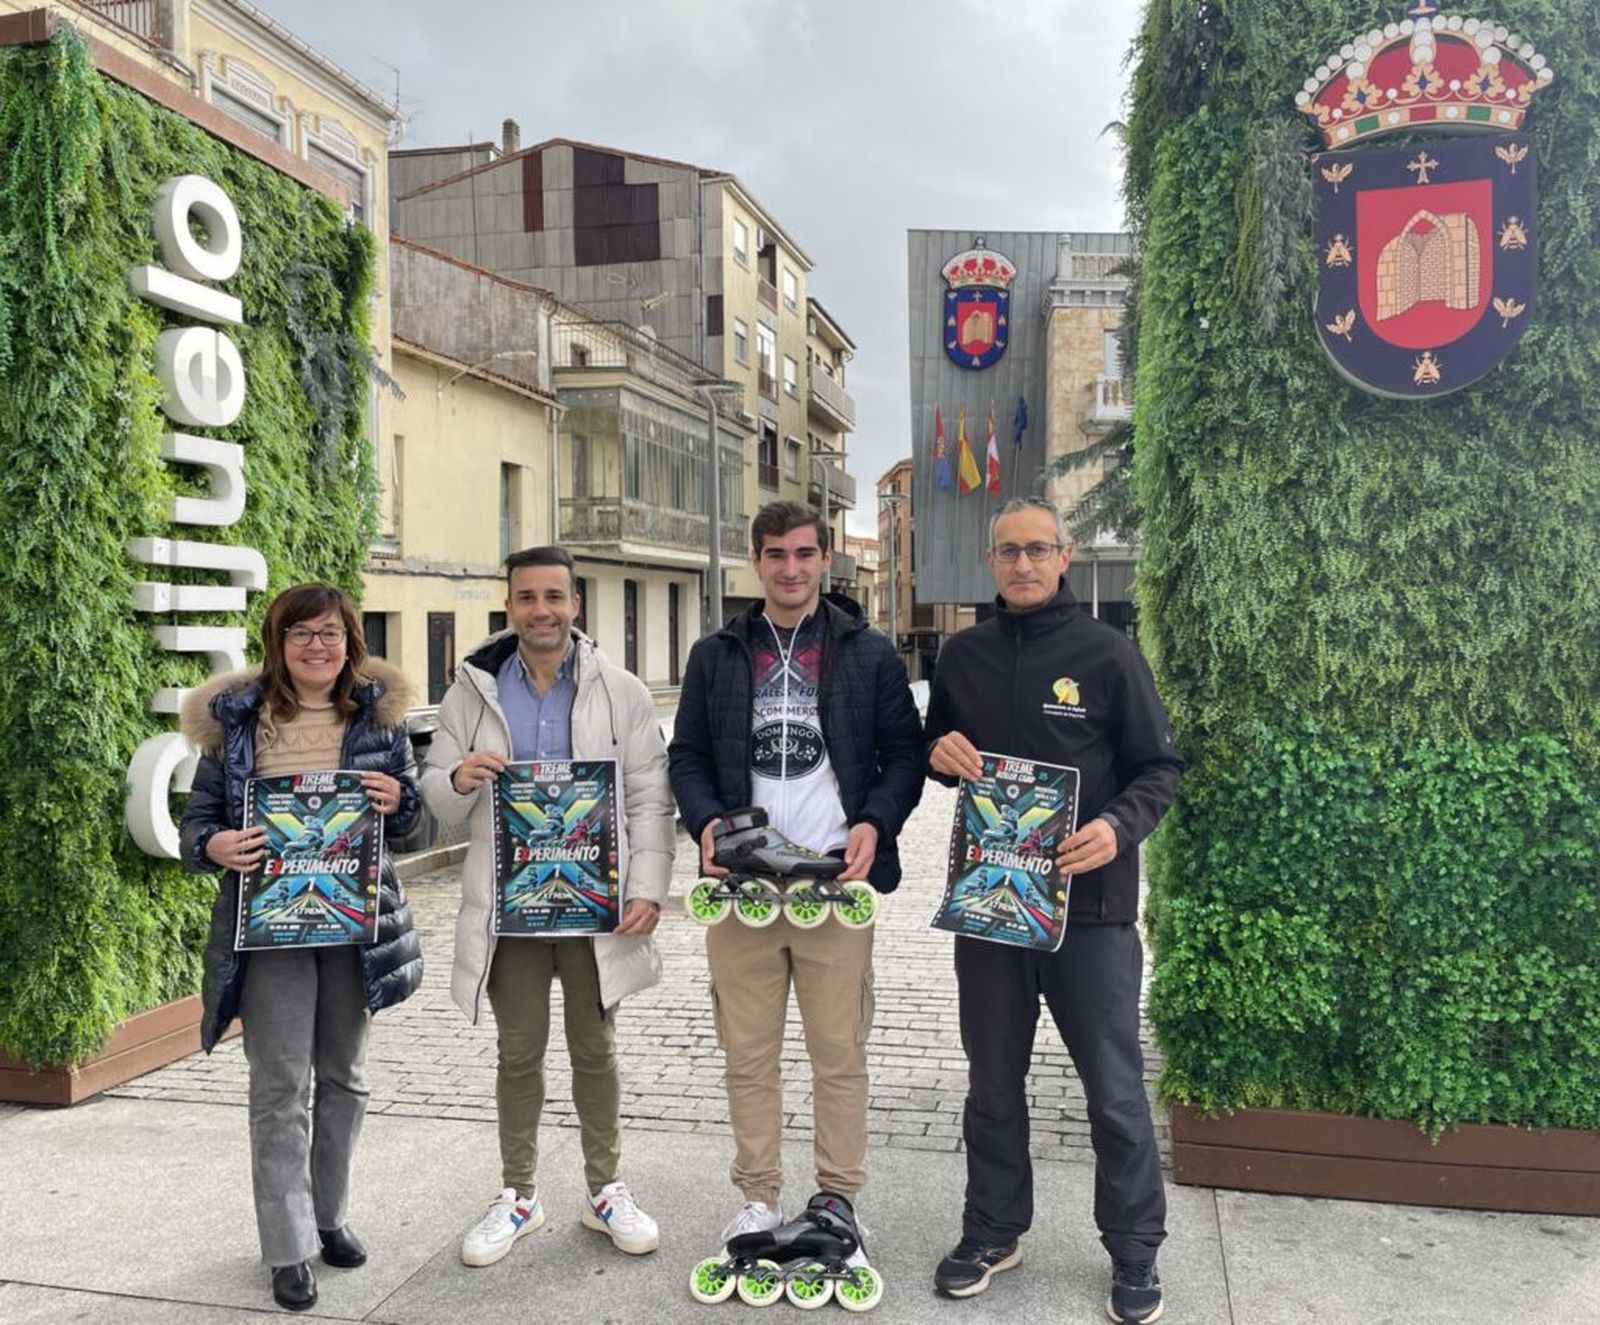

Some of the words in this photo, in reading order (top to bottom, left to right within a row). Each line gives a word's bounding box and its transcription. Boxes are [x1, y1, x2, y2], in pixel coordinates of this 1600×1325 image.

[514, 846, 600, 862] EXPERIMENTO
[966, 845, 1053, 875] EXPERIMENTO
[264, 859, 360, 875] EXPERIMENTO
